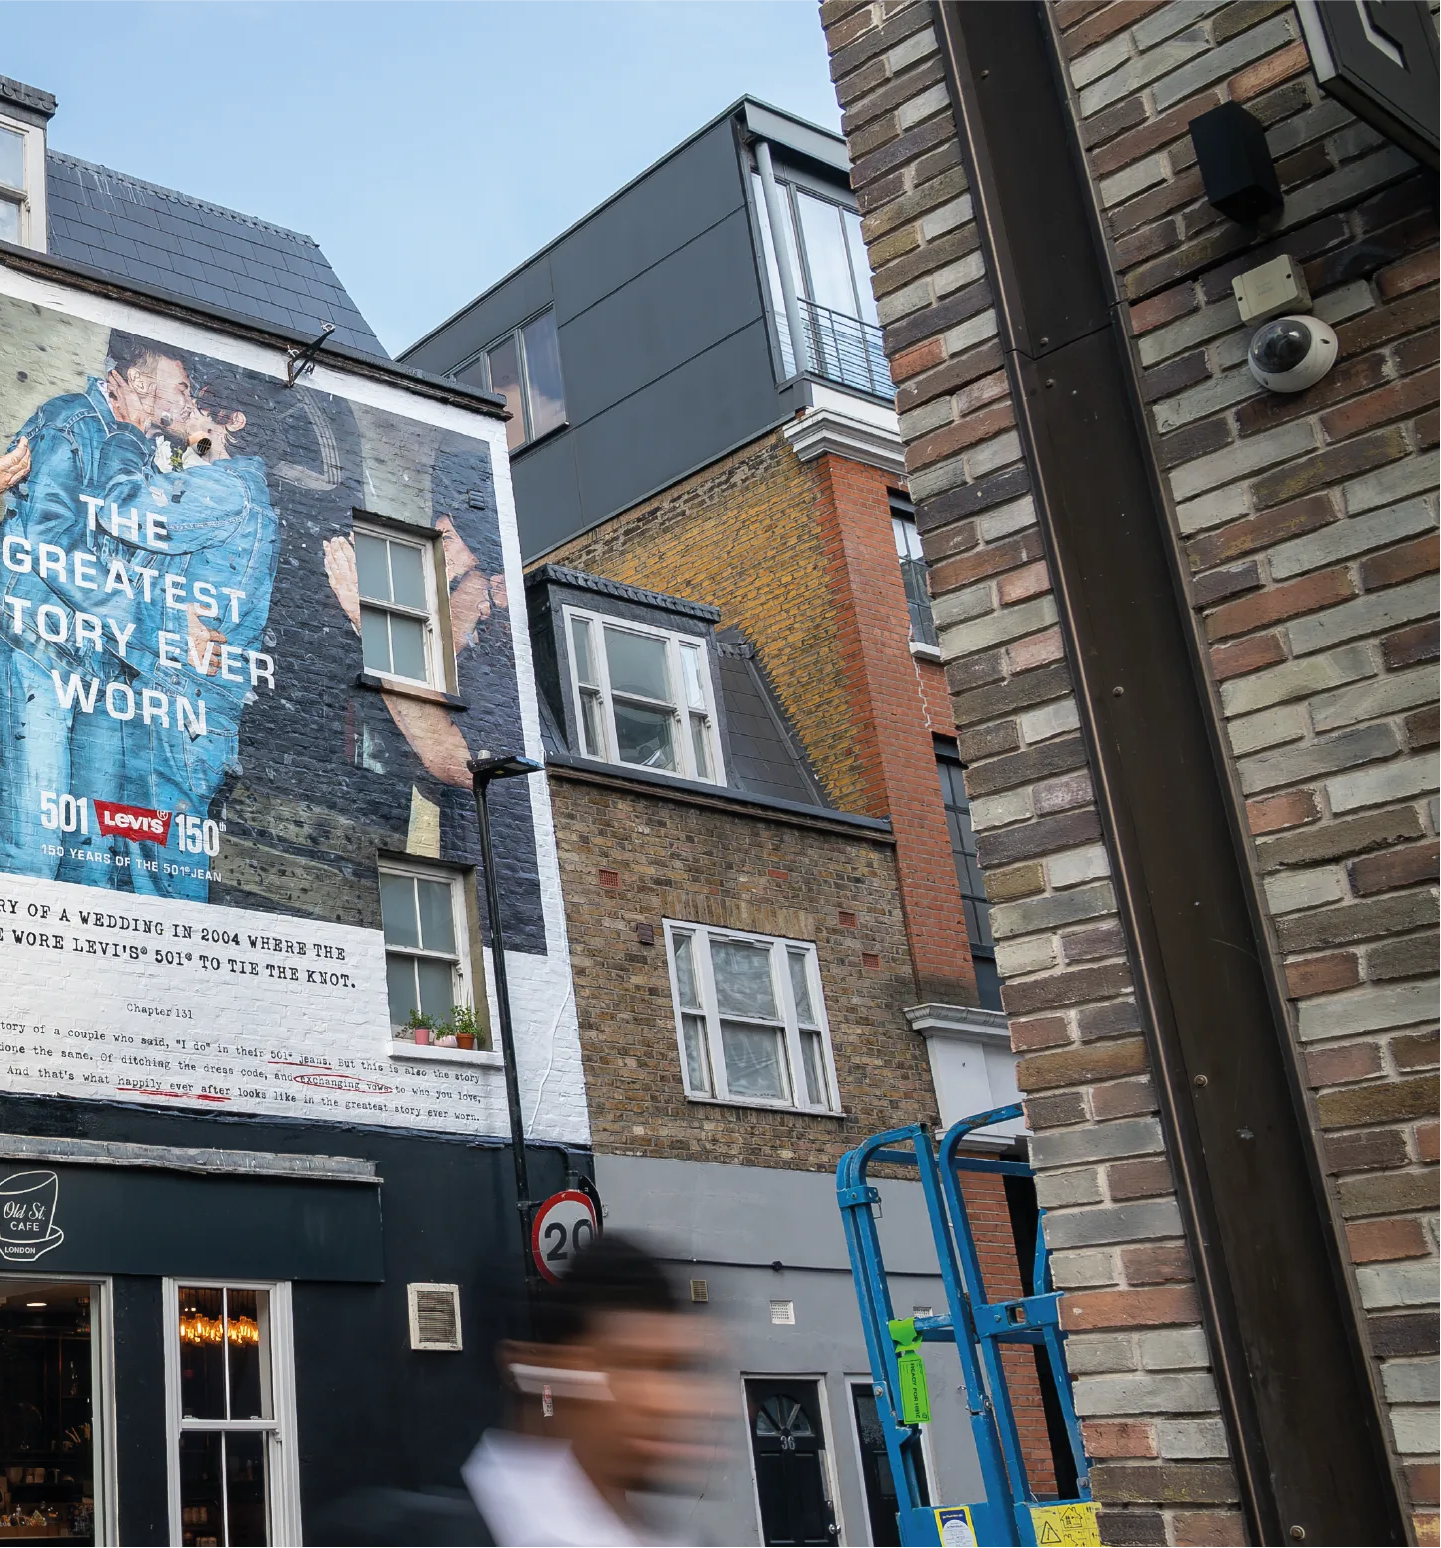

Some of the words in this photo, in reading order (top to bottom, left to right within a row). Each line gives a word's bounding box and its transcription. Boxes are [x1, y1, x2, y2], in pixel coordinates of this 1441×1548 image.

[79, 494, 168, 549] THE
[2, 536, 245, 623] GREATEST
[158, 630, 275, 689] EVER
[52, 670, 207, 736] WORN
[40, 790, 88, 835] 501
[41, 844, 64, 856] 150
[69, 848, 111, 864] YEARS
[115, 856, 131, 866] OF
[136, 859, 158, 872] THE
[12, 929, 64, 950] WORE
[199, 954, 221, 971] TO
[227, 958, 259, 975] TIE
[265, 964, 299, 981] THE
[306, 969, 356, 988] KNOT.
[27, 903, 51, 919] OF
[59, 908, 71, 922] A
[78, 911, 164, 936] WEDDING
[172, 924, 193, 939] IN
[201, 928, 241, 946] 2004
[247, 935, 307, 955] WHERE
[313, 943, 346, 961] THE
[127, 1003, 172, 1017] Chapter
[175, 1008, 193, 1019] 131
[33, 1025, 46, 1033] of
[54, 1028, 60, 1036] a
[68, 1030, 106, 1042] couple
[113, 1033, 134, 1043] who
[141, 1036, 169, 1048] said,
[176, 1039, 187, 1049] "I
[193, 1040, 211, 1051] do"
[217, 1044, 229, 1054] in
[236, 1045, 264, 1058] their
[299, 1053, 332, 1066] jeans.
[338, 1059, 355, 1069] But
[361, 1061, 384, 1072] this
[389, 1063, 399, 1073] is
[405, 1066, 427, 1077] also
[433, 1069, 450, 1079] the
[455, 1072, 479, 1084] story
[33, 1045, 53, 1056] the
[61, 1050, 94, 1061] same.
[101, 1053, 113, 1062] Of
[121, 1054, 171, 1070] ditching
[178, 1060, 196, 1071] the
[203, 1064, 234, 1075] dress
[240, 1067, 268, 1081] code,
[274, 1070, 294, 1081] and
[300, 1076, 360, 1091] exchanging
[366, 1082, 390, 1092] vows
[395, 1085, 406, 1094] to
[412, 1087, 430, 1097] who
[436, 1091, 452, 1100] you
[458, 1091, 481, 1104] love,
[7, 1065, 29, 1076] And
[38, 1068, 74, 1081] that's
[82, 1072, 110, 1084] what
[117, 1075, 161, 1090] happily
[169, 1083, 194, 1092] ever
[201, 1084, 231, 1096] after
[237, 1087, 267, 1099] looks
[274, 1091, 296, 1103] like
[303, 1094, 314, 1105] in
[321, 1097, 339, 1107] the
[345, 1100, 388, 1112] greatest
[394, 1105, 421, 1117] story
[427, 1109, 448, 1118] ever
[454, 1112, 480, 1122] worn.
[3, 1200, 27, 1219] Old
[28, 1201, 47, 1220] St.
[10, 1221, 40, 1231] CAFE
[4, 1246, 36, 1254] LONDON
[544, 1219, 594, 1261] 20
[780, 1435, 795, 1450] 36
